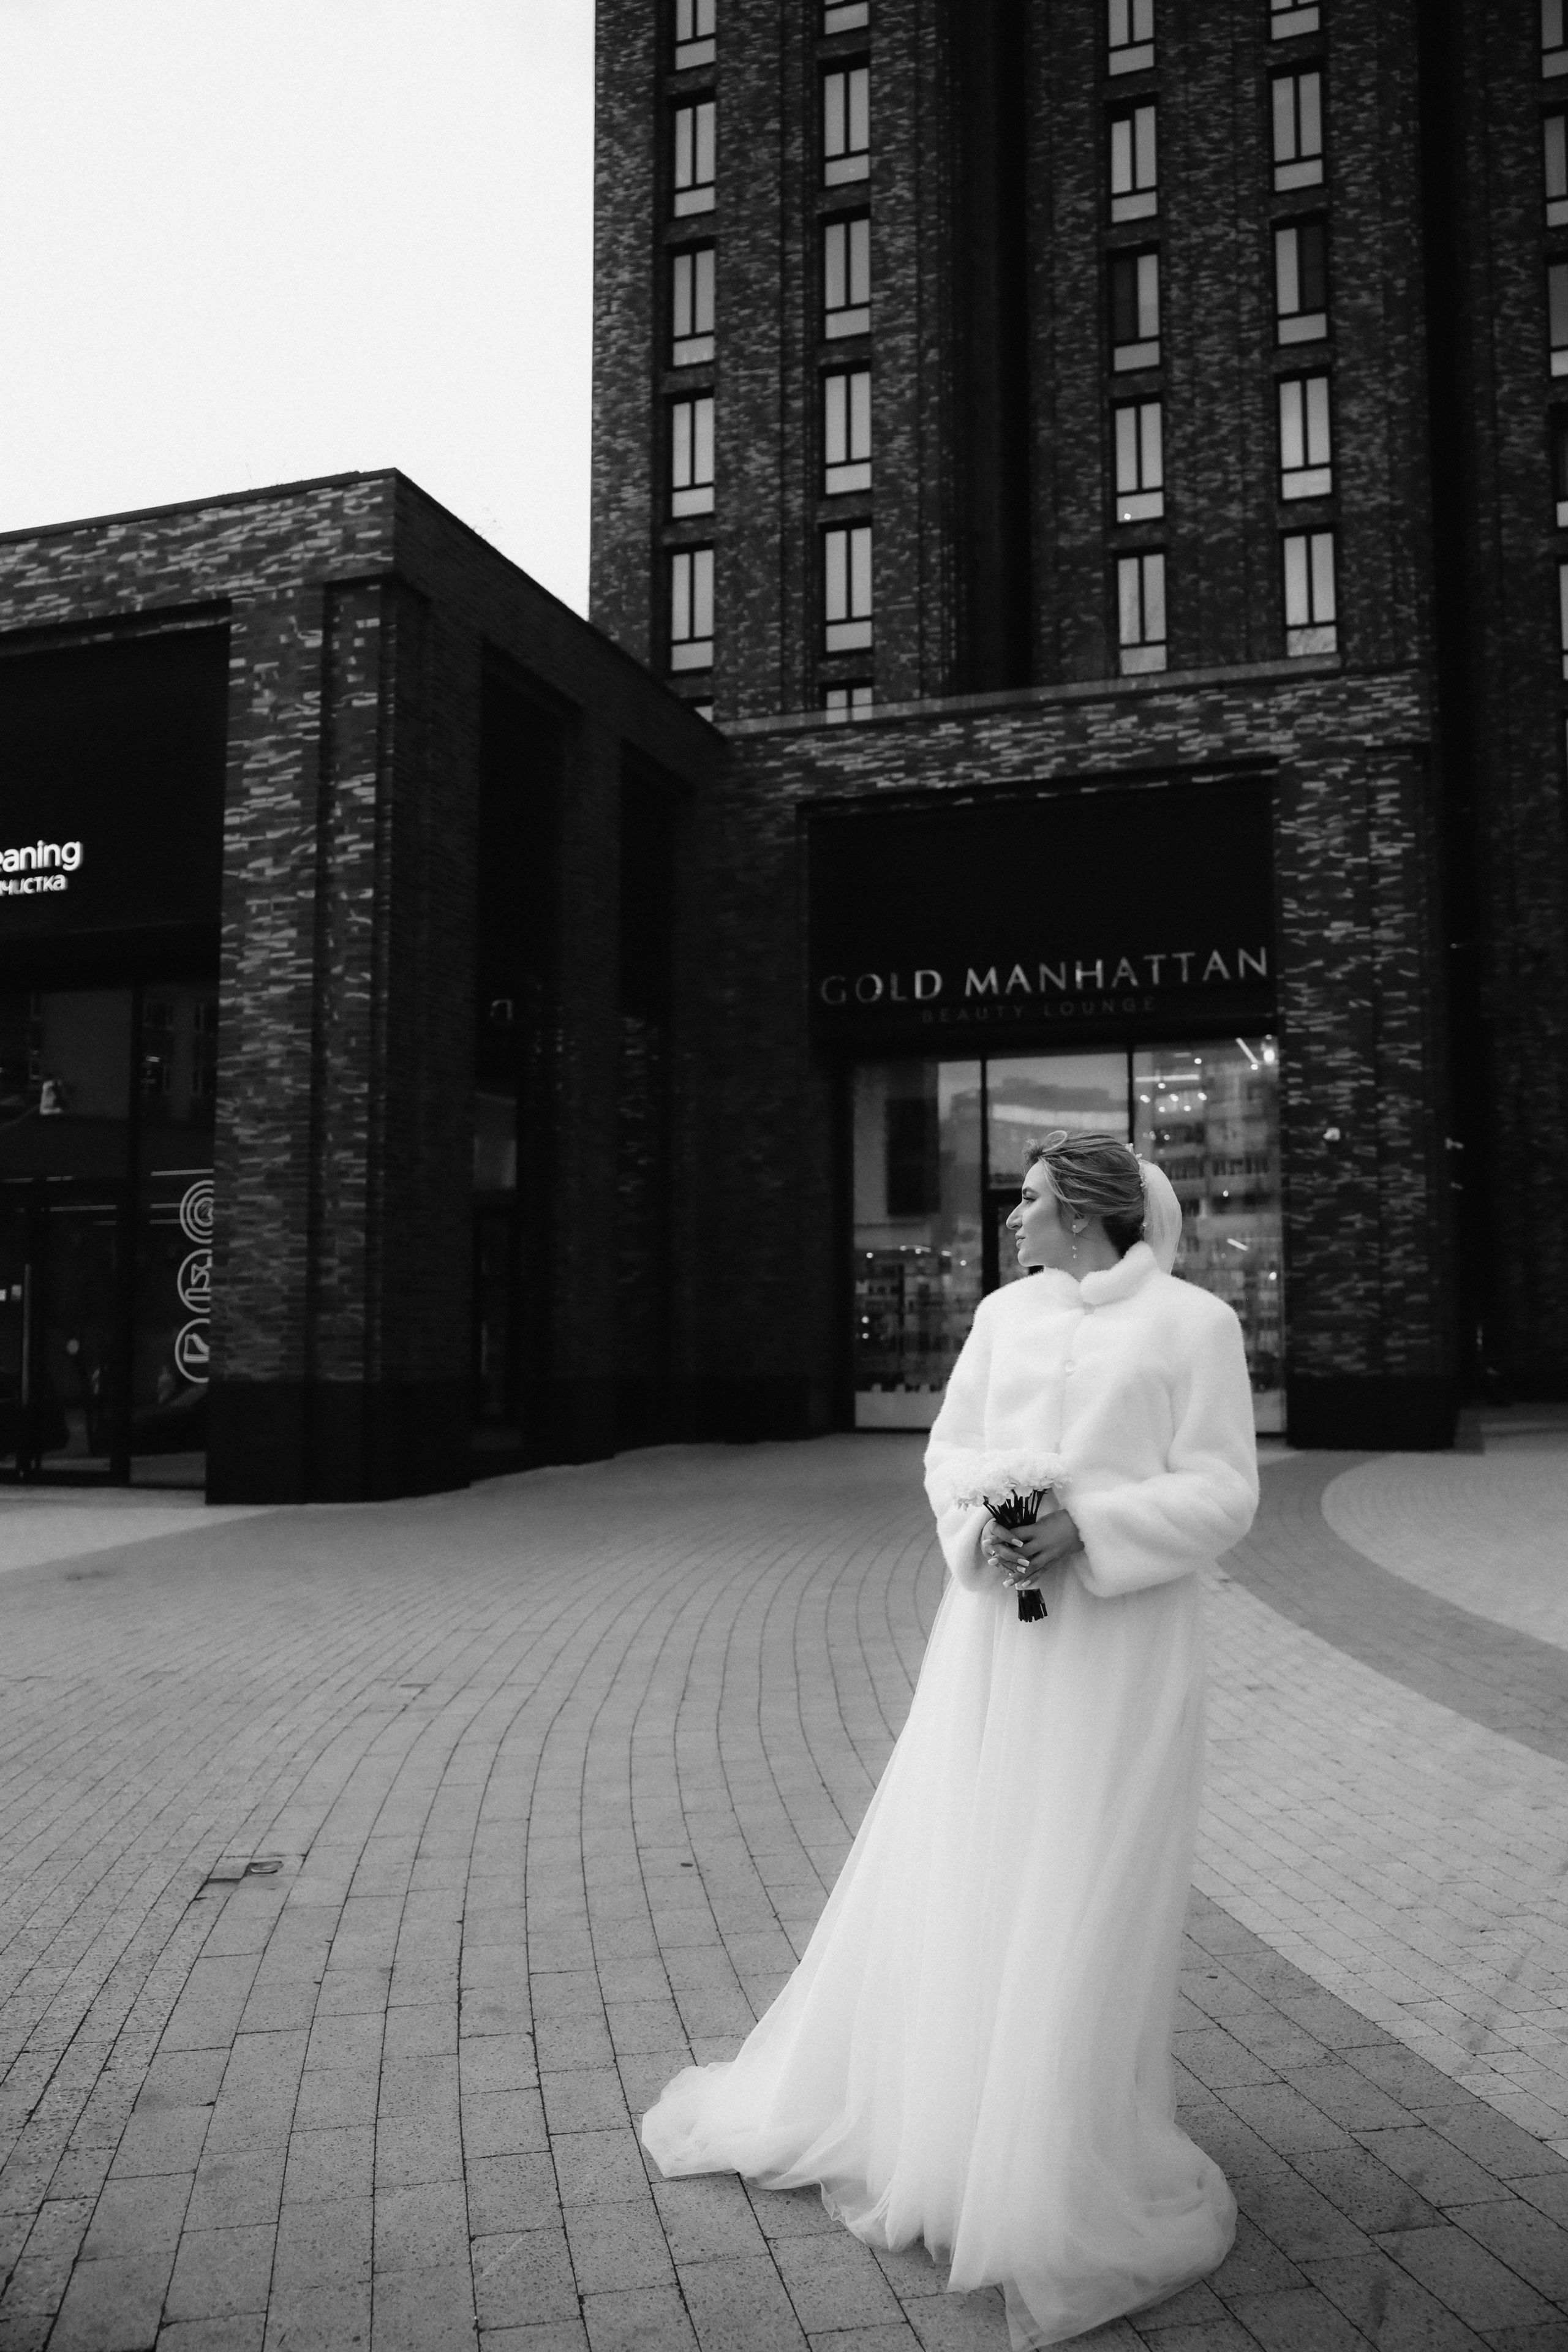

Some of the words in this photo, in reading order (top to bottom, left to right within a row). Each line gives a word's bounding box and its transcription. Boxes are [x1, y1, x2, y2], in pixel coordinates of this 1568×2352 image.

[0, 840, 83, 872] aning
[0, 874, 68, 897] чистка
[820, 968, 943, 1005] GOLD
[964, 946, 1268, 997] MANHATTAN
[921, 1003, 1024, 1024] BEAUTY
[1042, 996, 1156, 1018] LOUNGE
